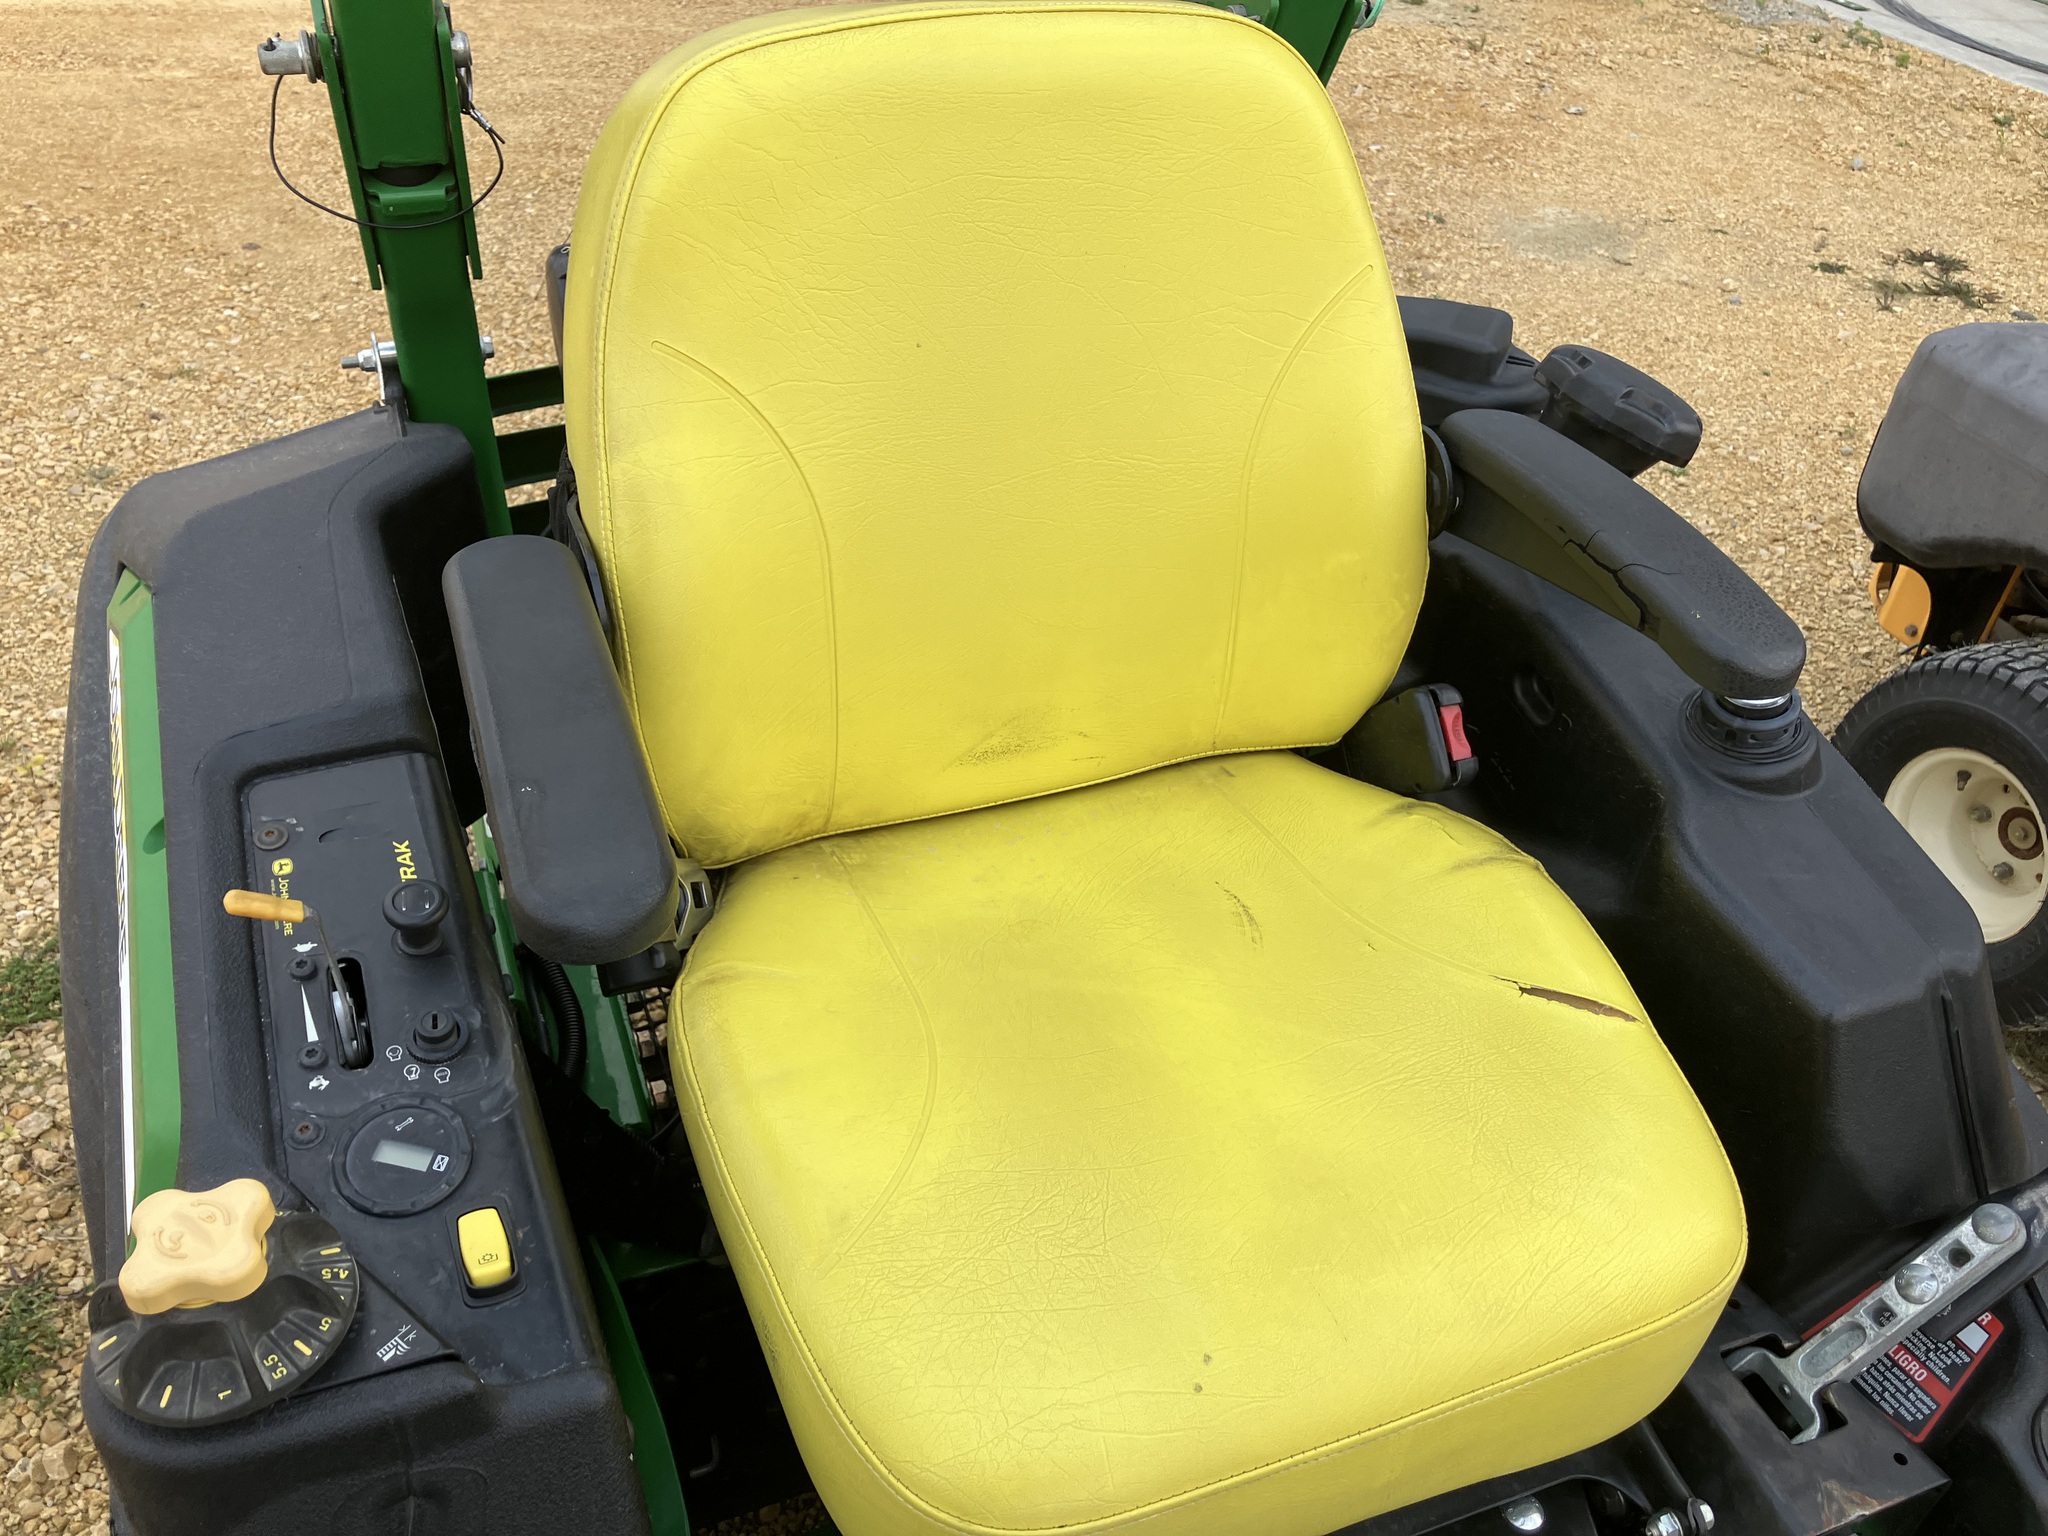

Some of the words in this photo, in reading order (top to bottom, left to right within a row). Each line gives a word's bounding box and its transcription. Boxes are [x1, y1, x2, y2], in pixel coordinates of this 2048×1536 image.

[392, 840, 418, 882] RAK
[319, 1317, 332, 1332] 5
[263, 1354, 288, 1380] 5.5
[1888, 1343, 1928, 1383] LIGRO
[1901, 1336, 1927, 1362] pecially
[1925, 1358, 1952, 1385] children.
[1927, 1350, 1946, 1369] Never
[1936, 1349, 1952, 1366] Look
[1947, 1350, 1964, 1366] near.
[1955, 1348, 1971, 1363] stop
[1891, 1366, 1907, 1382] parar
[1905, 1378, 1915, 1388] las
[1882, 1390, 1900, 1408] Nunca
[1897, 1405, 1914, 1422] llevar
[1894, 1390, 1917, 1414] mientras
[1915, 1411, 1924, 1420] se
[1907, 1392, 1917, 1401] No
[1914, 1398, 1931, 1415] cortar
